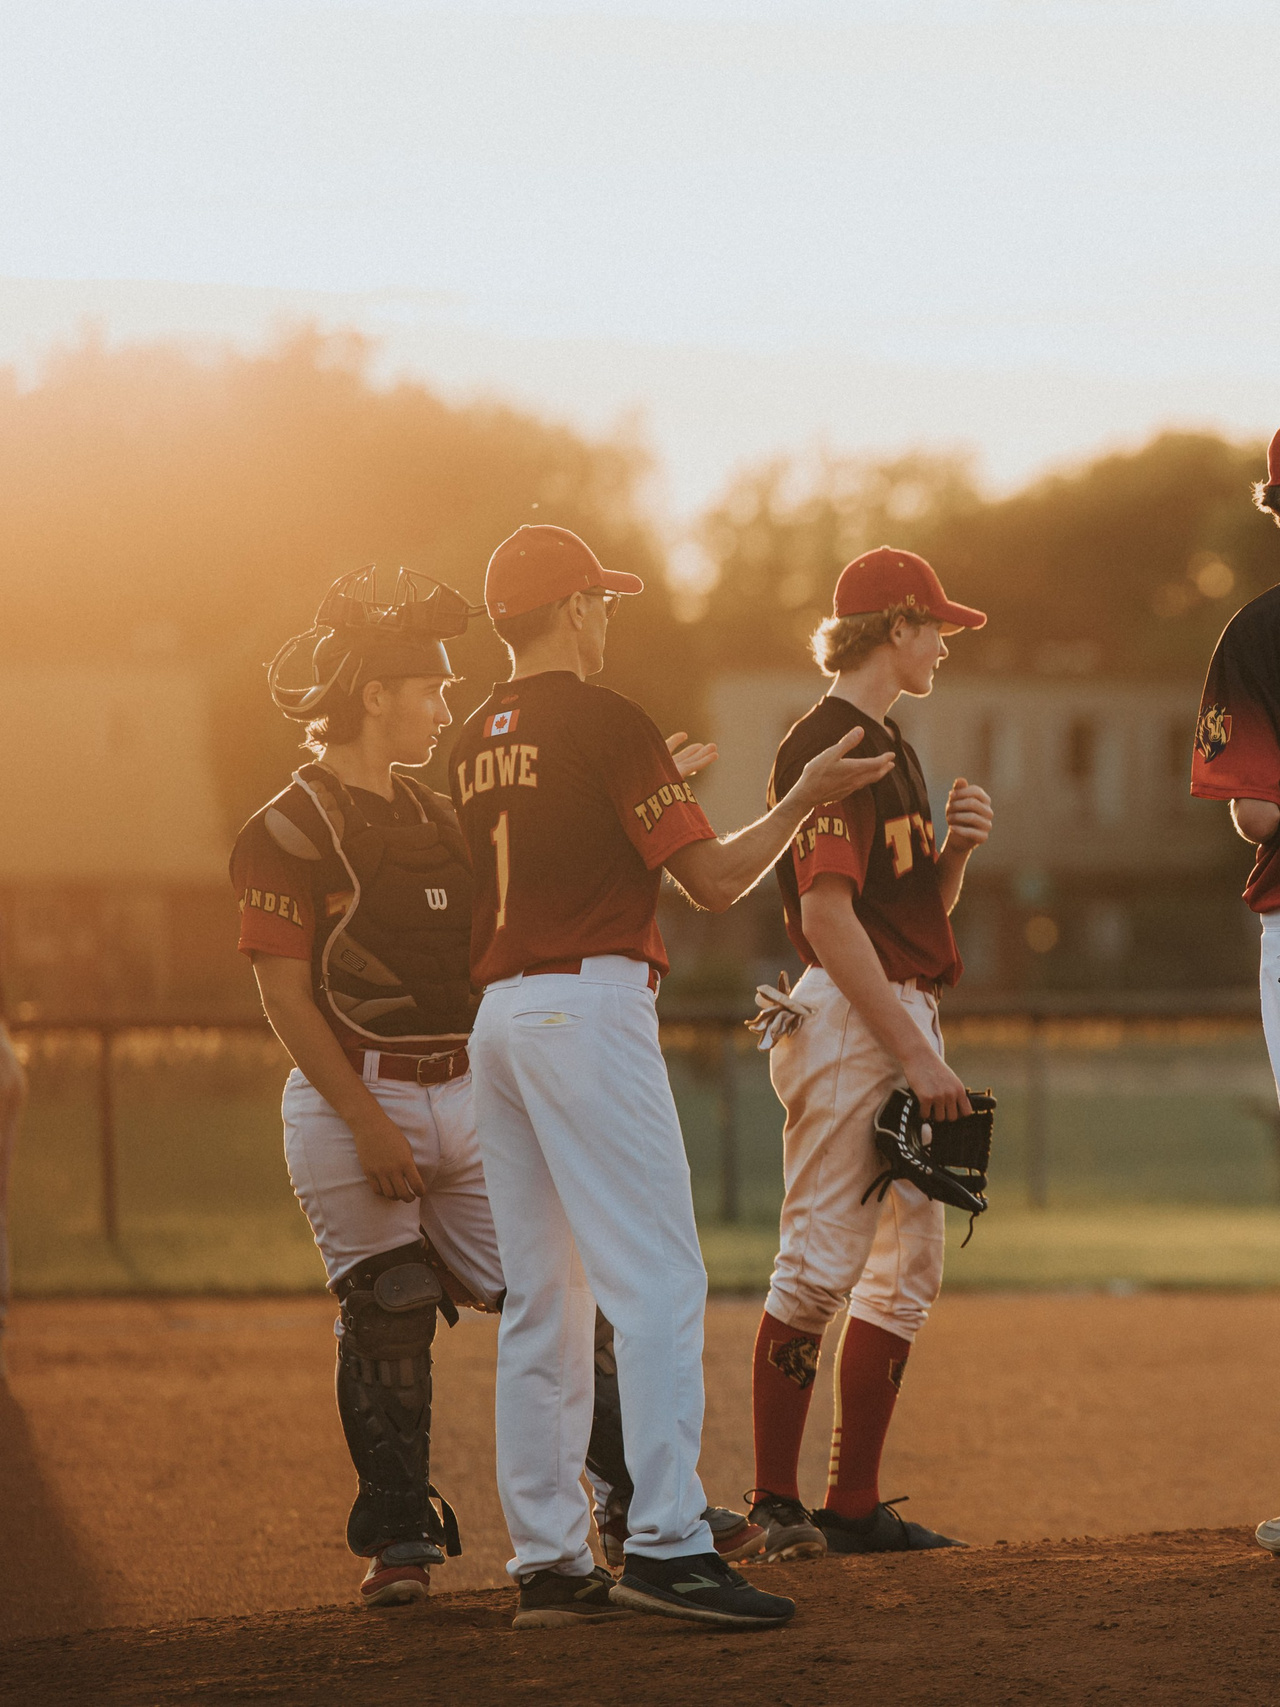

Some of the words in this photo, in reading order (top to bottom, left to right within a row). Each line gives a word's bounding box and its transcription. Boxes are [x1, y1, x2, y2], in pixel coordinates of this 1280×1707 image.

[905, 594, 916, 606] 16
[457, 744, 538, 806] LOWE
[490, 810, 510, 931] 1
